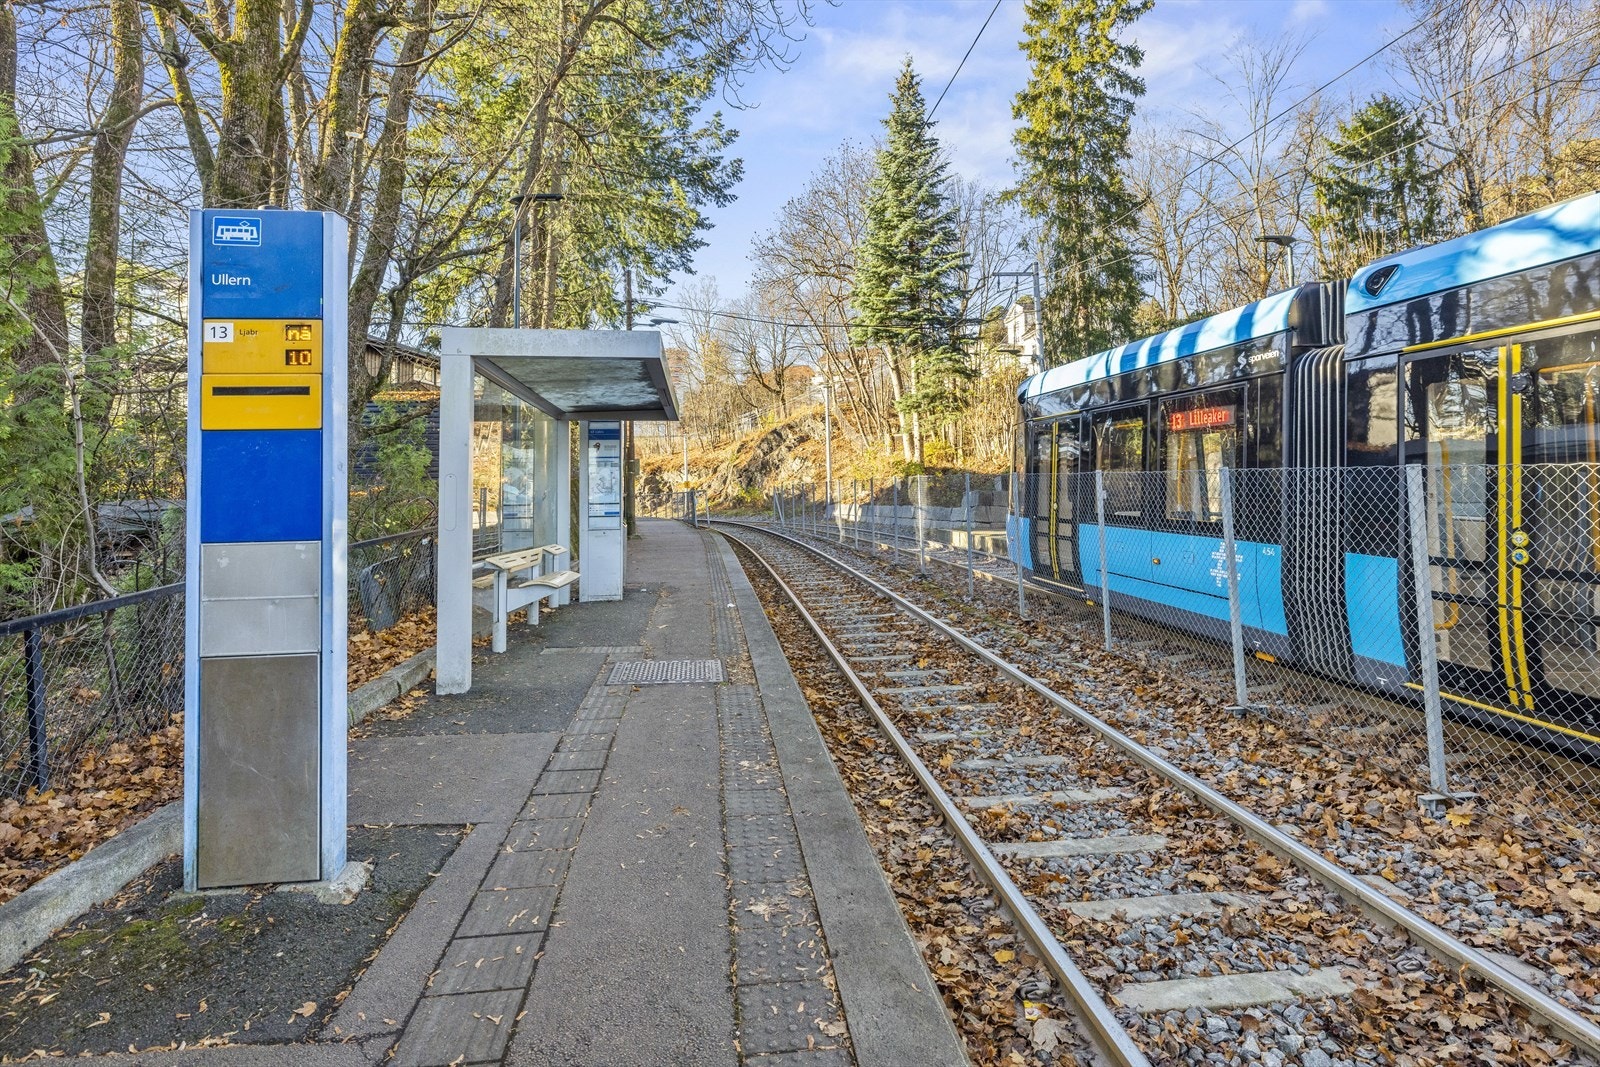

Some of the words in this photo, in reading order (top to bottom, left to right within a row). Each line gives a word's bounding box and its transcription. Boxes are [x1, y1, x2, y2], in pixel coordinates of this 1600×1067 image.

[211, 273, 251, 286] Ullern
[210, 326, 228, 339] 13
[287, 325, 312, 341] nå
[288, 351, 312, 365] 10
[1171, 413, 1183, 429] 13
[1189, 409, 1226, 426] Lilleaker
